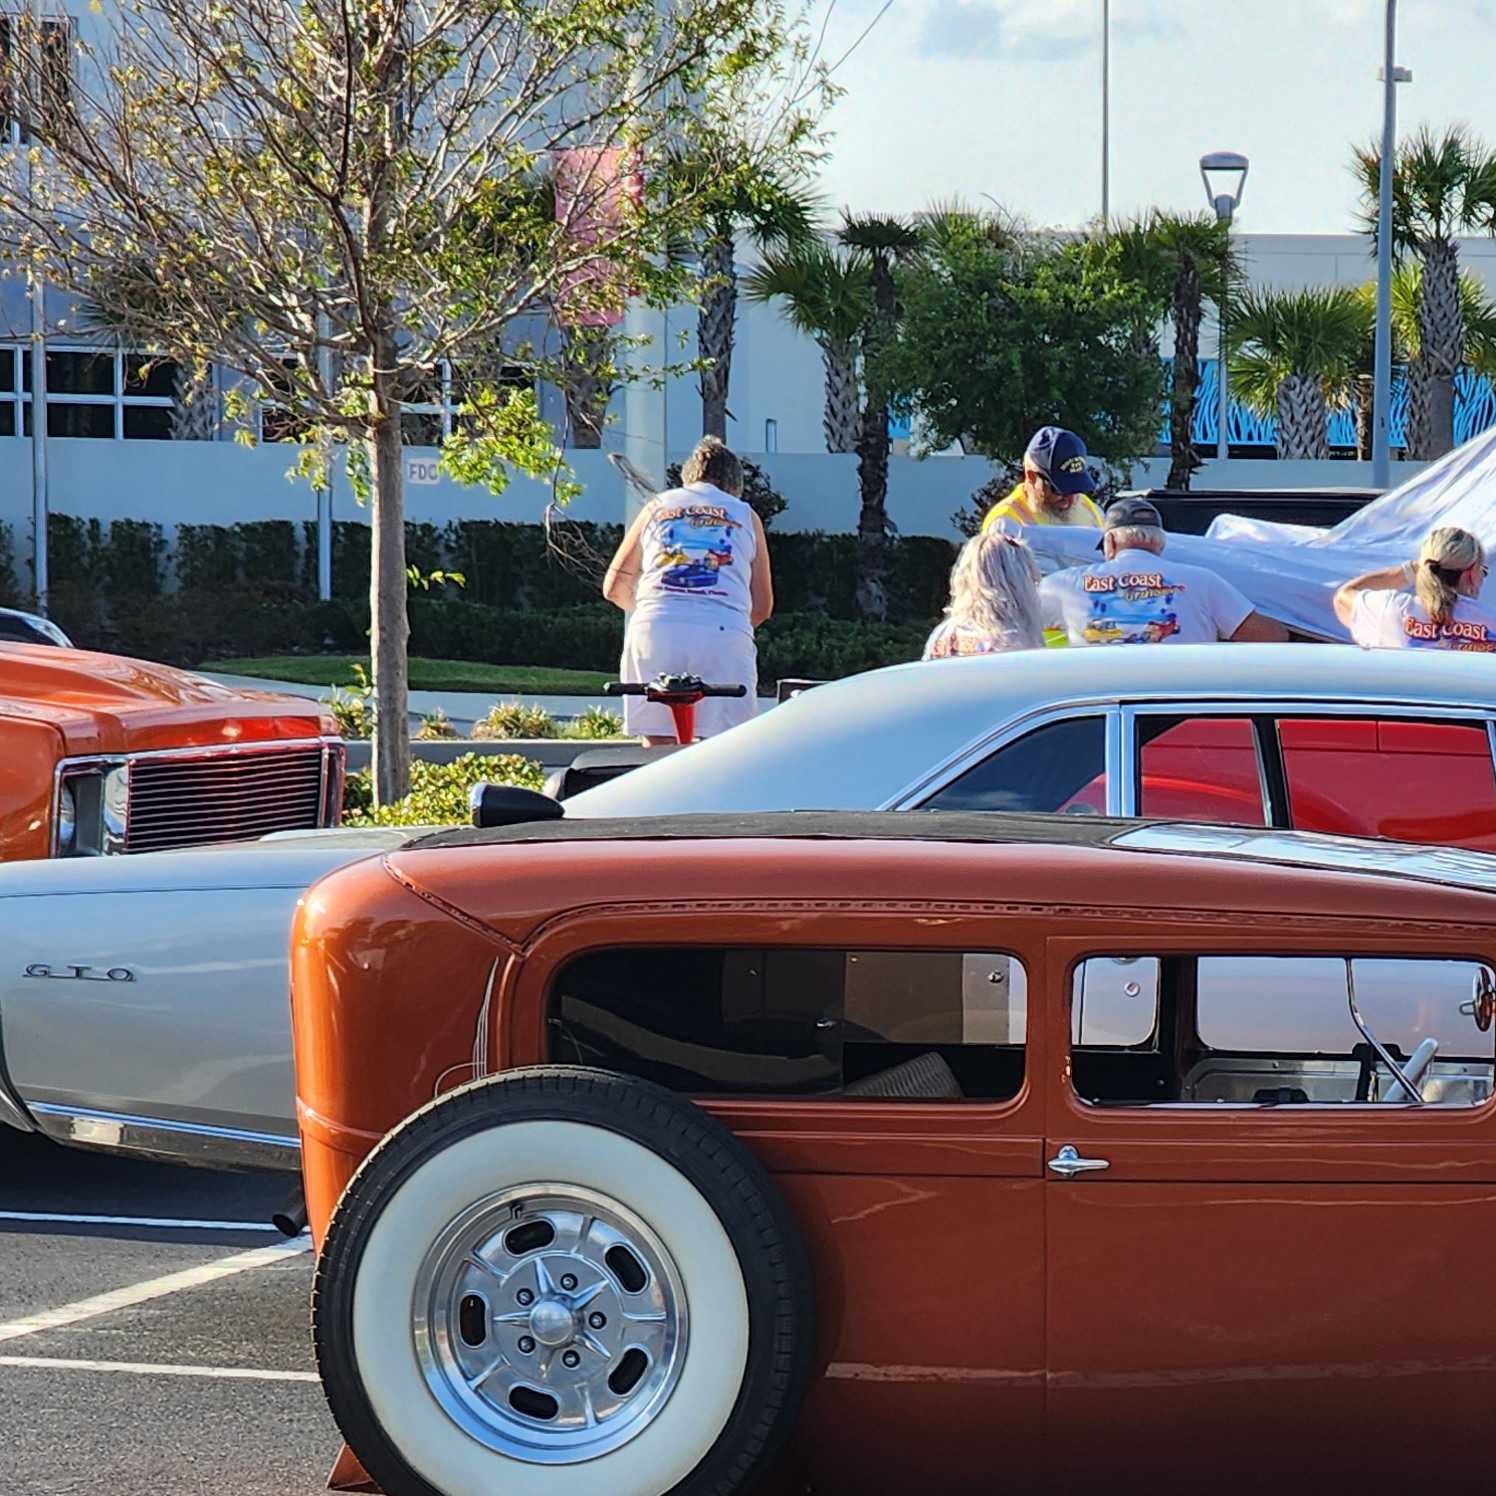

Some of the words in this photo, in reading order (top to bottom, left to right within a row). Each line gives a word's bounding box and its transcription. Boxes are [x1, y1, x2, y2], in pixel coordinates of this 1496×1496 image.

[409, 463, 438, 480] FDC
[1083, 575, 1116, 592] East
[1117, 572, 1163, 588] Coast
[1440, 621, 1488, 641] Coast
[22, 963, 136, 981] GTO
